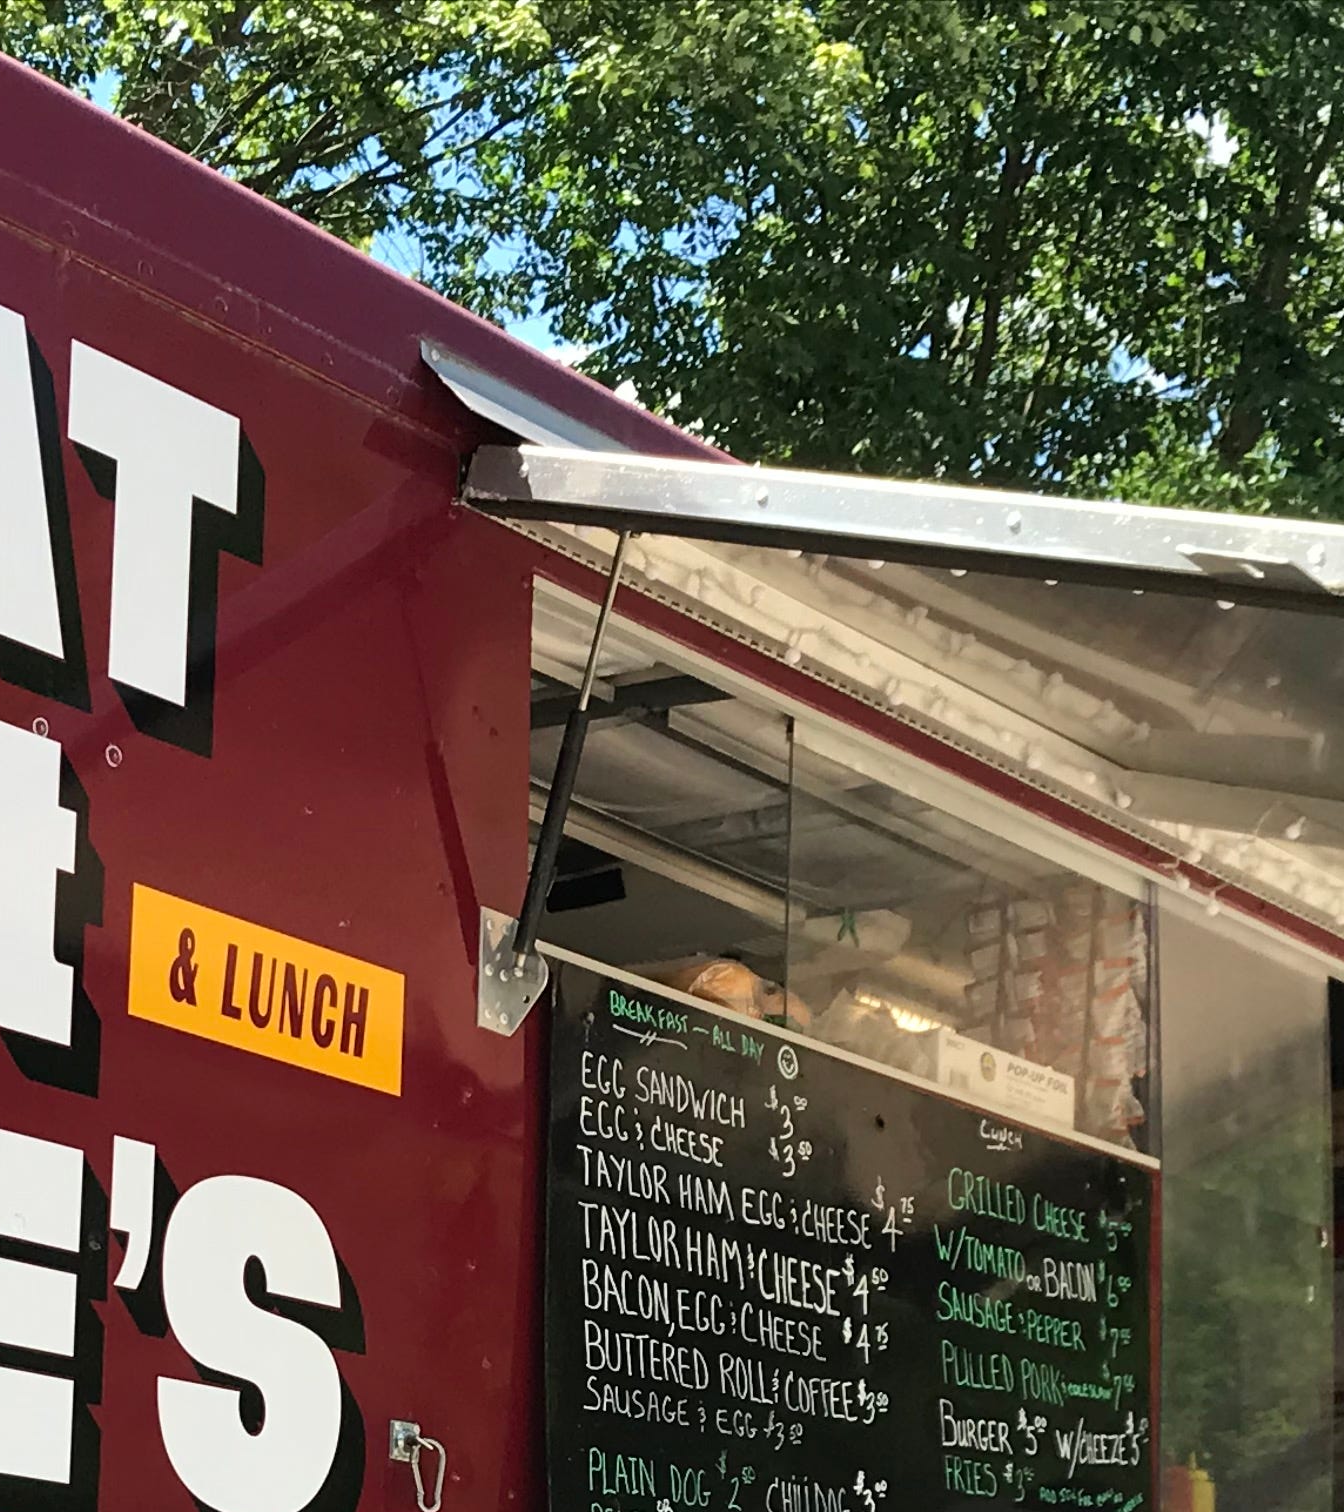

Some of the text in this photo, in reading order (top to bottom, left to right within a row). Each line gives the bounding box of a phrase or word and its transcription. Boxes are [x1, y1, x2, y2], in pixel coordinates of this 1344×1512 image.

[167, 925, 371, 1059] & LUNCH
[610, 990, 689, 1033] BREAKFAST
[712, 1025, 736, 1052] ALL
[741, 1034, 764, 1064] DAY
[582, 1051, 626, 1099] EGG
[635, 1066, 745, 1129] SANDWICH
[579, 1096, 628, 1142] EGG
[650, 1115, 725, 1168] CHEESE
[576, 1145, 671, 1206] TAYLOR
[679, 1174, 735, 1222] HAM
[742, 1187, 786, 1230] EGG
[802, 1199, 873, 1250] CHEESE
[948, 1167, 1026, 1225] GRILLED
[1033, 1193, 1090, 1243] CHEESE
[578, 1201, 681, 1270] TAYLOR
[687, 1227, 746, 1291] HAM
[758, 1248, 841, 1317] CHEESE
[1043, 1257, 1097, 1302] BACON
[677, 1289, 726, 1336] EGG
[741, 1301, 827, 1362] CHEESE
[937, 1280, 1017, 1334] SAUSAGE
[1028, 1308, 1086, 1351] PEPPER
[583, 1375, 690, 1426] SAUSAGE
[716, 1408, 757, 1439] EGG
[584, 1319, 709, 1391] BUTTERED
[719, 1353, 774, 1405] ROLL
[785, 1370, 858, 1422] COFFEE
[942, 1340, 1015, 1392] PULLED
[1020, 1358, 1064, 1407] PORK
[589, 1446, 656, 1498] PLAIN
[669, 1463, 712, 1507] DOG
[945, 1455, 998, 1497] FRIES
